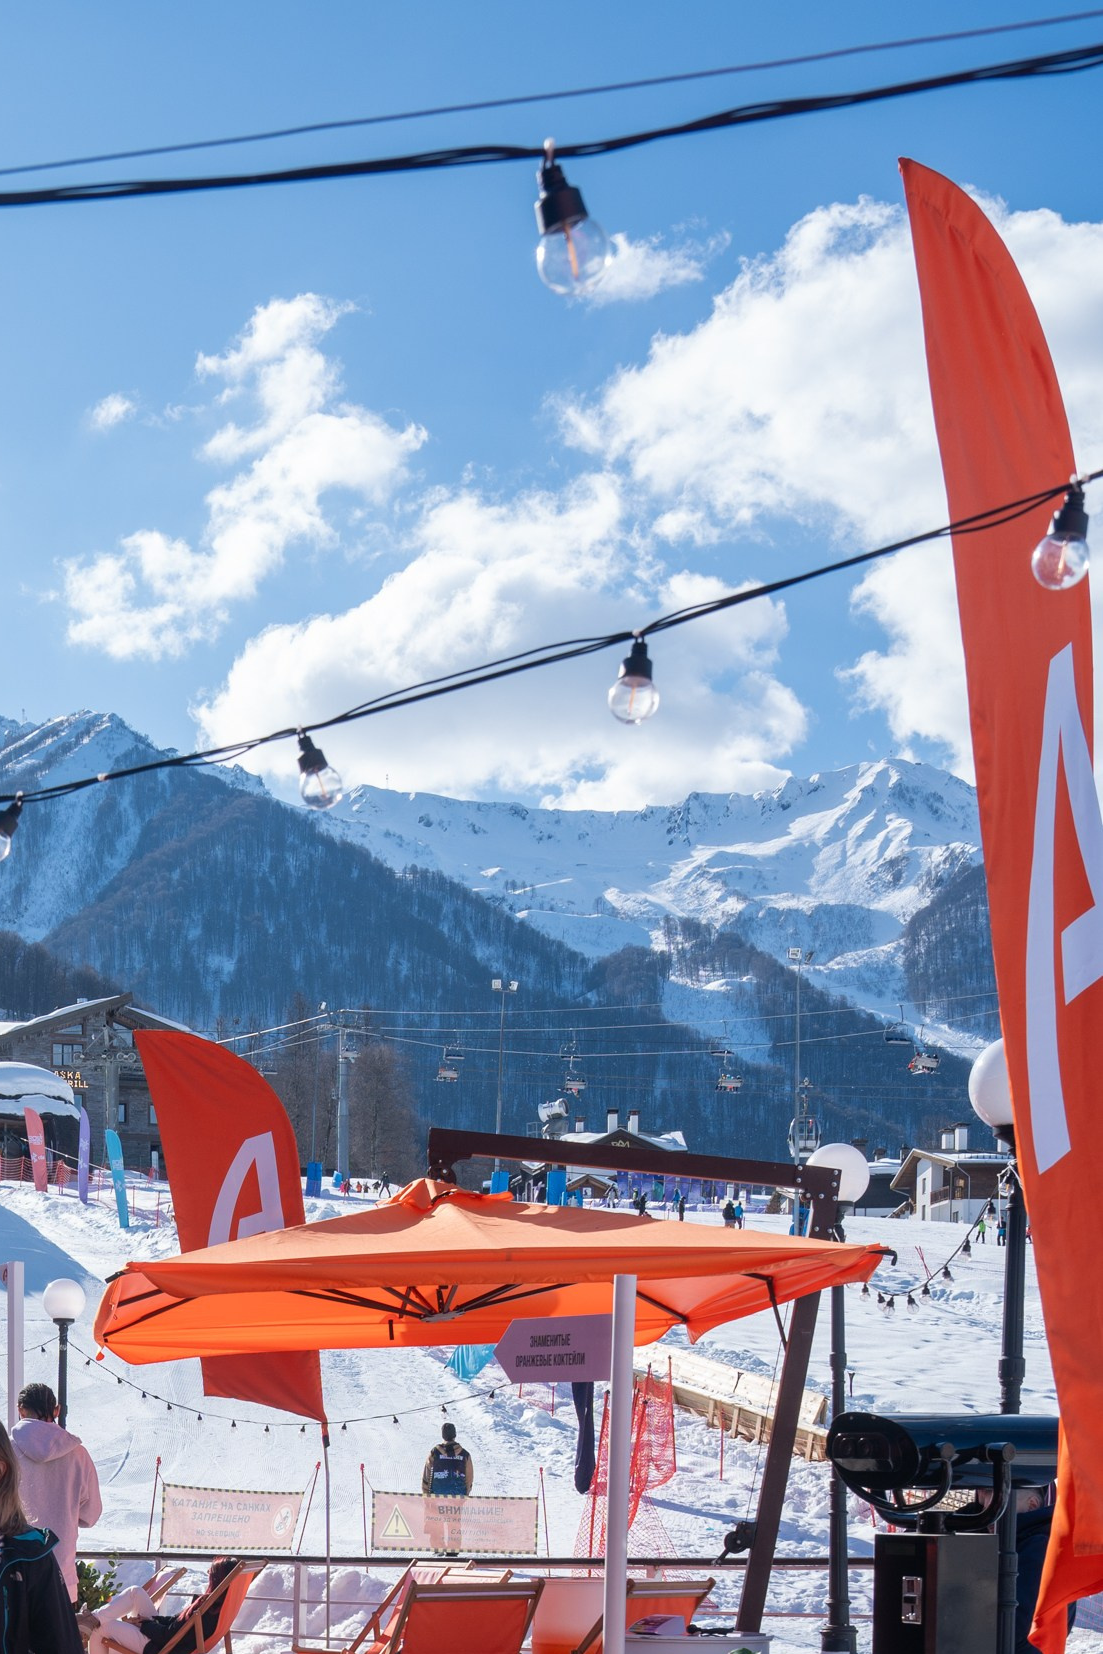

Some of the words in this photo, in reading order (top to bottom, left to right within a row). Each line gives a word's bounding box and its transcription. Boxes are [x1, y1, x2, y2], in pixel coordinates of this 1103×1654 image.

[208, 1131, 285, 1248] A
[529, 1334, 571, 1348] ЗНАМЕНИТЫЕ
[515, 1353, 553, 1368] ОРАНЖЕВЫЕ
[553, 1351, 586, 1366] КОКТЕЙЛИ
[172, 1497, 218, 1509] КАТАНИЕ
[221, 1501, 234, 1511] НА
[236, 1502, 271, 1512] САНКАХ
[438, 1505, 504, 1516] ВНИМАНИЕ!
[191, 1511, 251, 1524] ЗАПРЕЩЕНО
